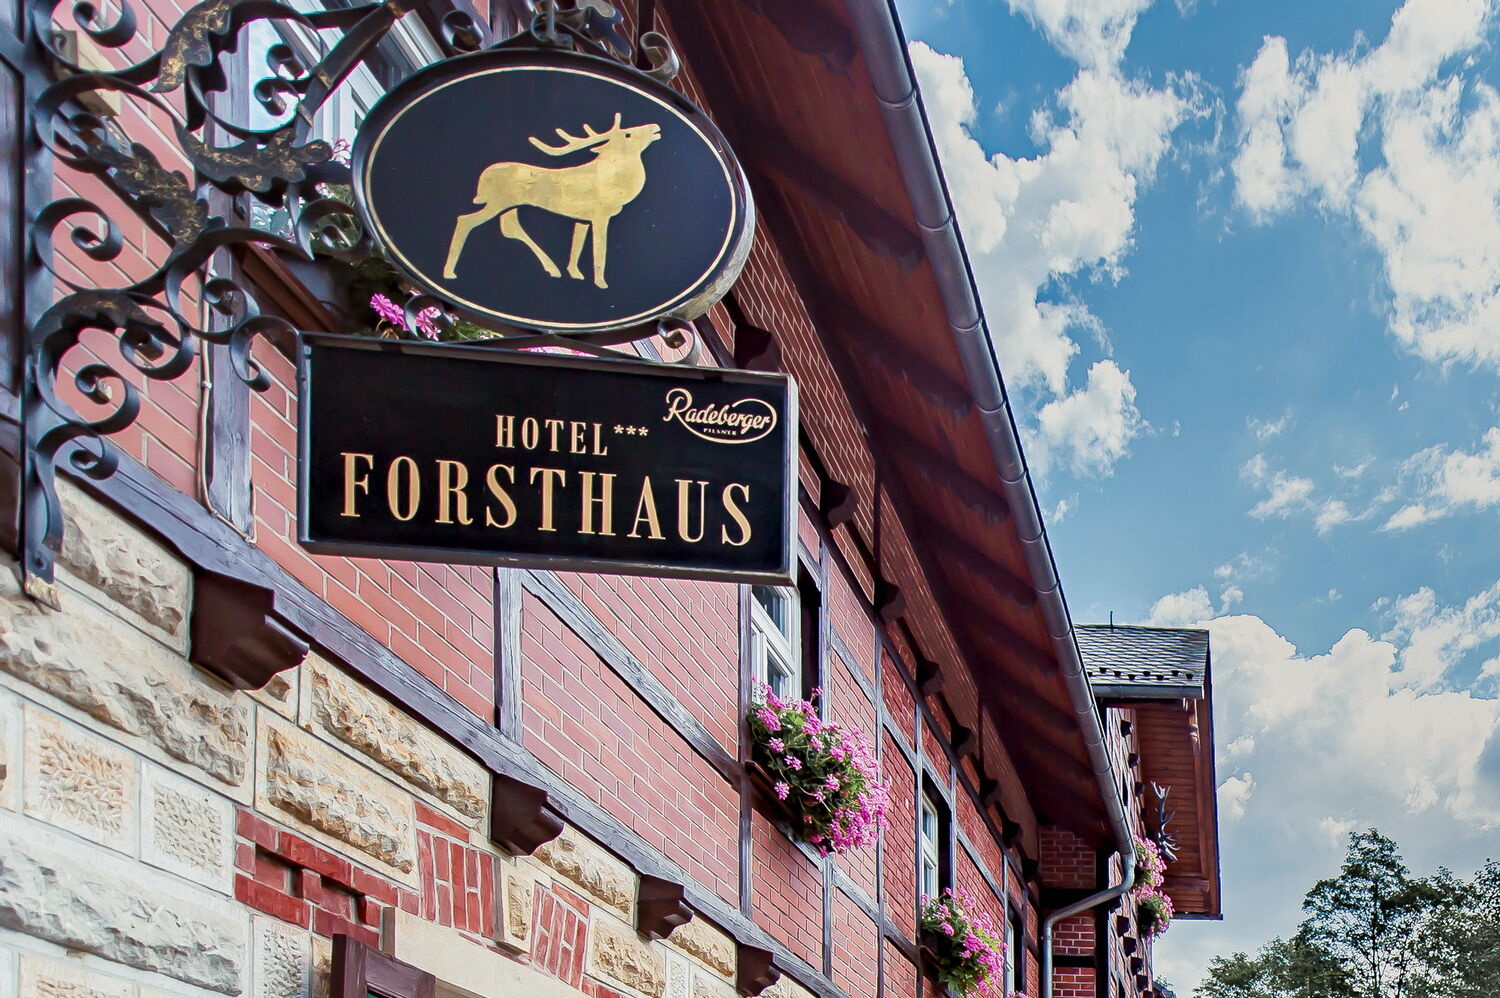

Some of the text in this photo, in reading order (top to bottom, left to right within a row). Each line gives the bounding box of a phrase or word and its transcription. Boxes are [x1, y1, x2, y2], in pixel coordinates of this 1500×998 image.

[663, 387, 771, 435] Radeberger
[703, 427, 738, 437] PILSNER
[495, 414, 608, 456] HOTEL
[340, 451, 752, 547] FORSTHAUS
